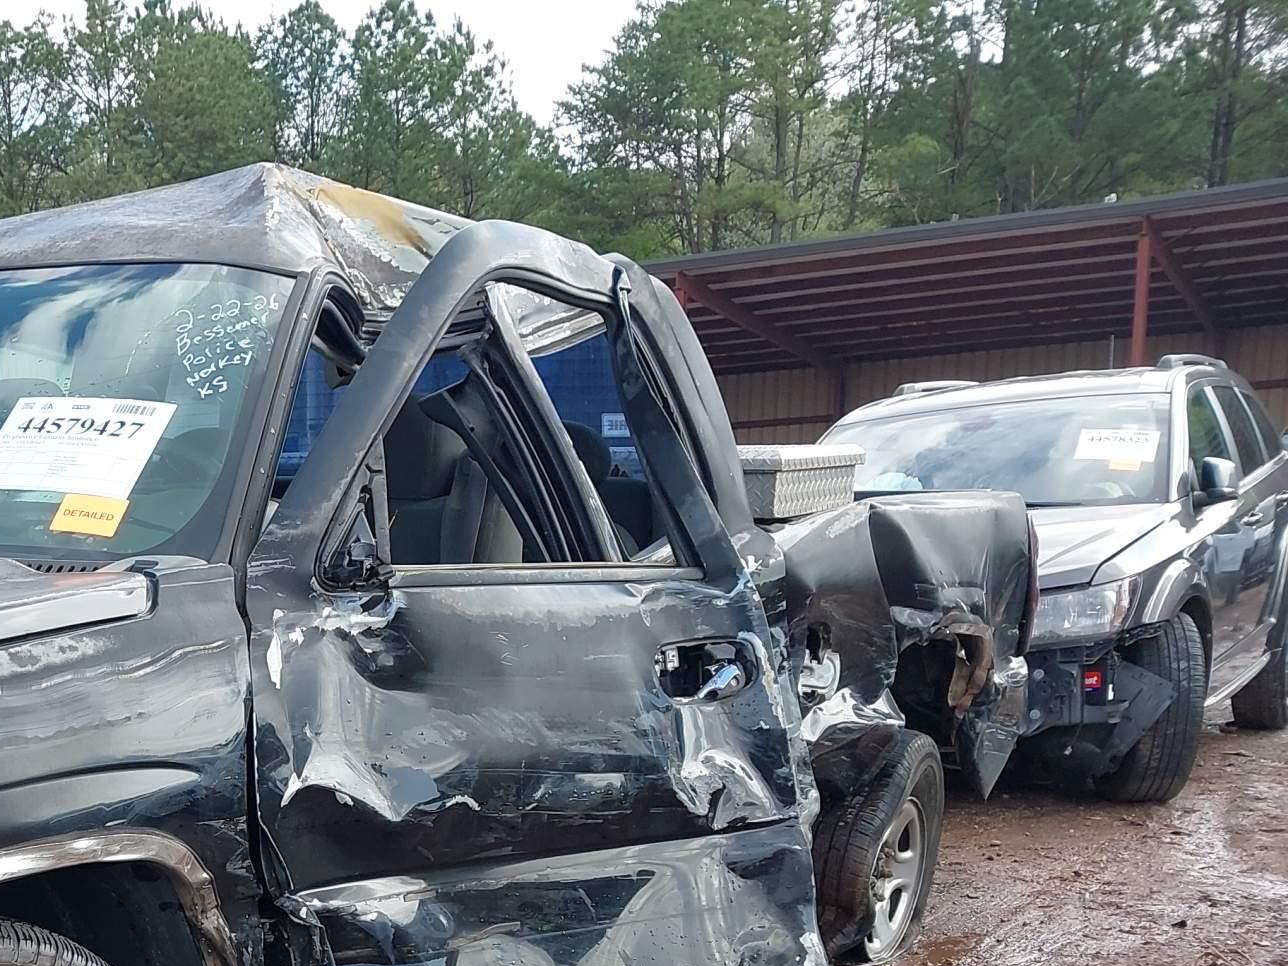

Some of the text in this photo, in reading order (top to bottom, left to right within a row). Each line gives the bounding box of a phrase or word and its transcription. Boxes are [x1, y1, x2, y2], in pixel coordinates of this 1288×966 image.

[175, 293, 279, 333] 2-22-26
[18, 417, 145, 439] 44579427
[63, 508, 114, 521] DETAILED
